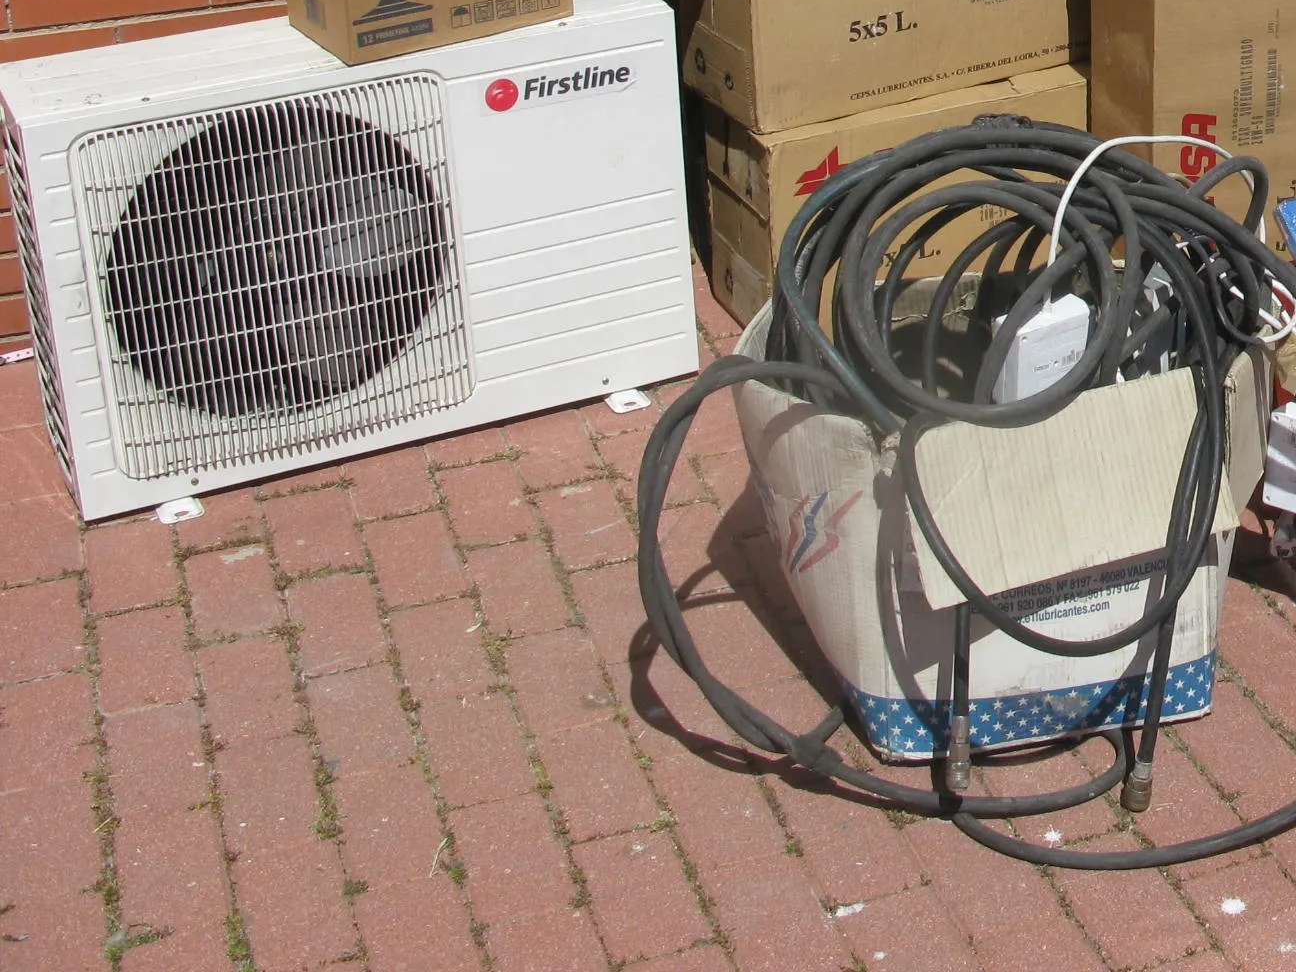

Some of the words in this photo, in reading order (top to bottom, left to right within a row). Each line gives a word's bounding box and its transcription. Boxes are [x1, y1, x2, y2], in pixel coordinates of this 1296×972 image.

[848, 14, 889, 43] 5x5
[895, 10, 919, 33] L.
[523, 65, 631, 101] Firstline
[849, 90, 877, 102] CEPSA
[877, 75, 935, 94] LUBRICANTES,
[967, 61, 997, 74] RIBERA
[997, 56, 1014, 67] DEL
[1014, 50, 1041, 63] LOIRA,
[1069, 575, 1092, 590] 8197
[1106, 583, 1121, 597] 579
[1124, 580, 1140, 593] 022
